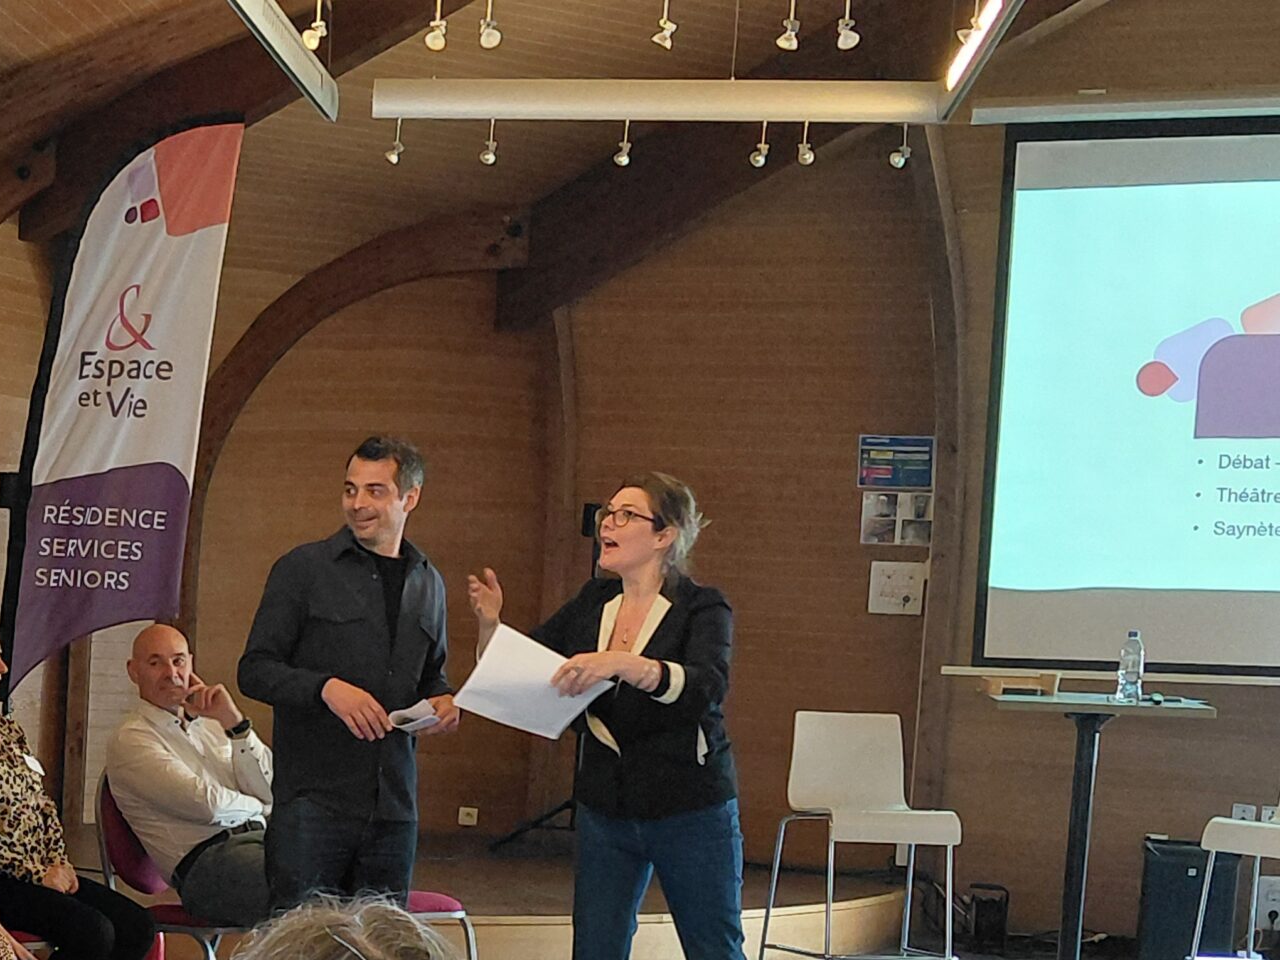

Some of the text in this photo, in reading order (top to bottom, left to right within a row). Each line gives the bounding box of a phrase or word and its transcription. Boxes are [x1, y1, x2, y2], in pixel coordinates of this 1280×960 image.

[105, 284, 157, 351] &
[78, 351, 174, 386] Espace
[78, 387, 148, 418] et Vie
[1218, 453, 1271, 469] Débat
[43, 499, 168, 530] RÉSIDENCE
[38, 537, 143, 561] SERVICES
[34, 567, 130, 590] SENIORS
